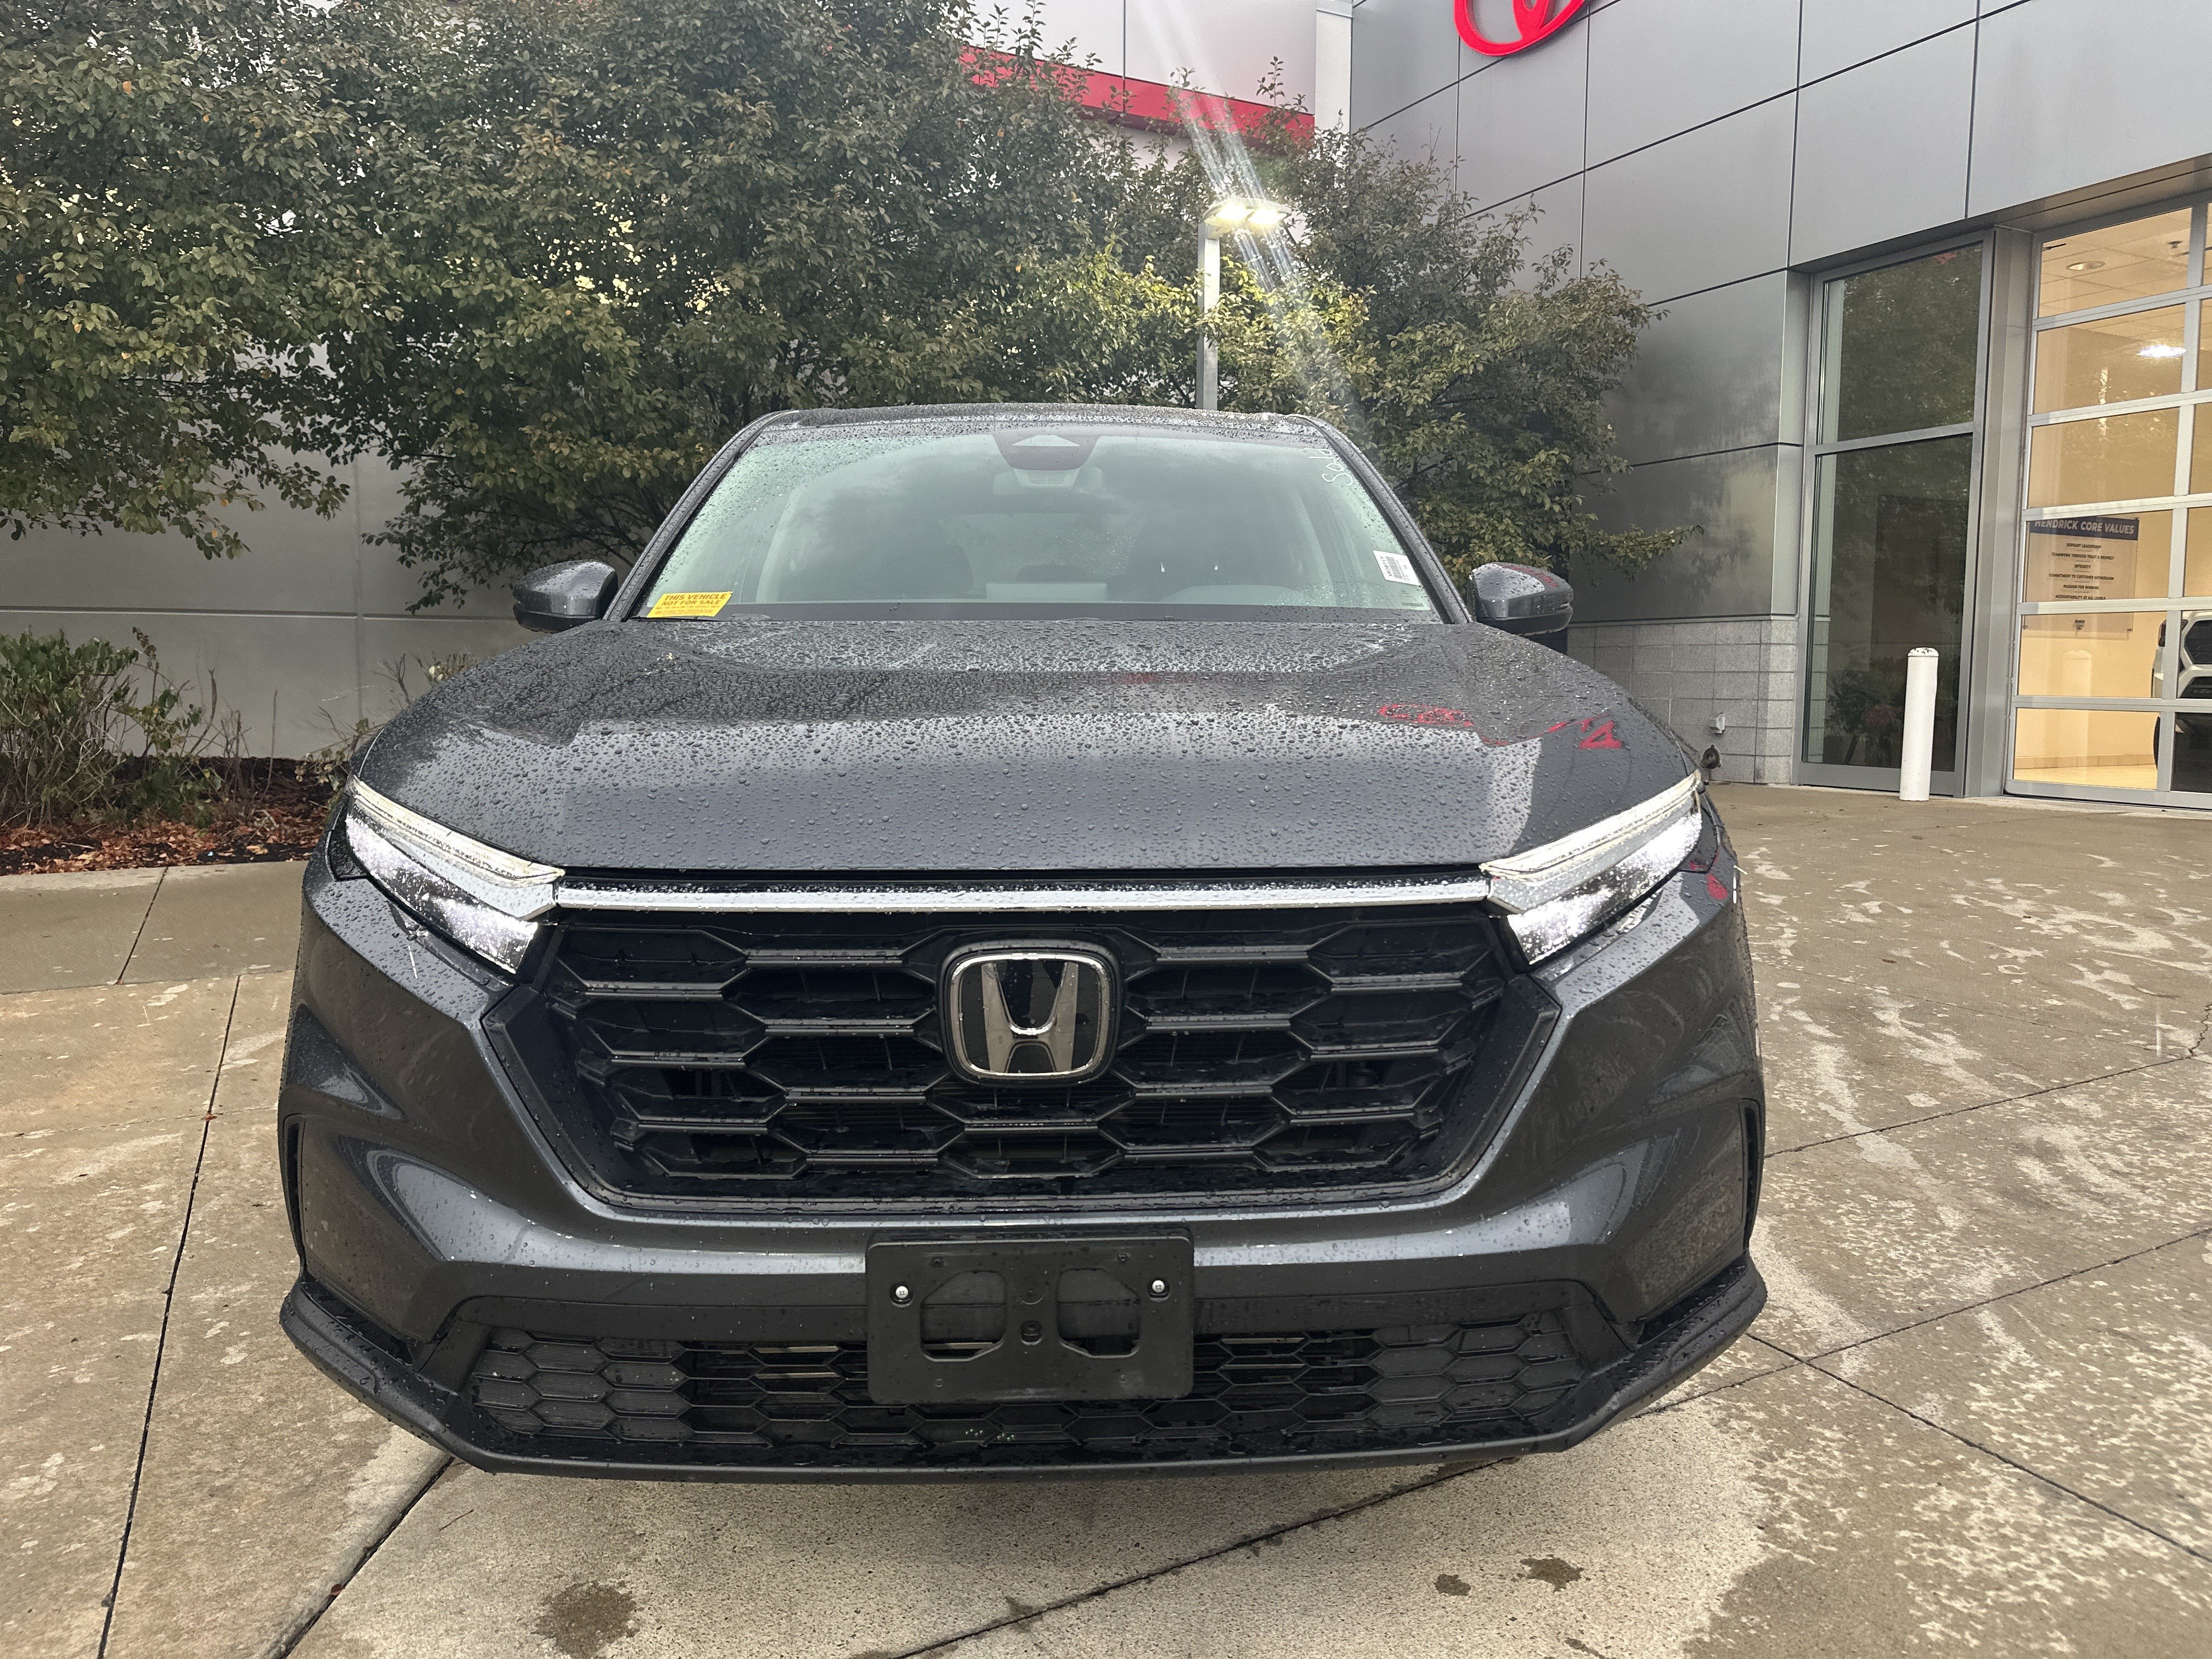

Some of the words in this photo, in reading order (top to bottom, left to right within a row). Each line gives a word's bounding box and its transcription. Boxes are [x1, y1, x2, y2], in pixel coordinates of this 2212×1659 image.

[1304, 447, 1353, 486] Sold
[2034, 520, 2078, 530] HENDRICK
[2080, 521, 2102, 532] CORE
[2104, 523, 2135, 534] VALUES
